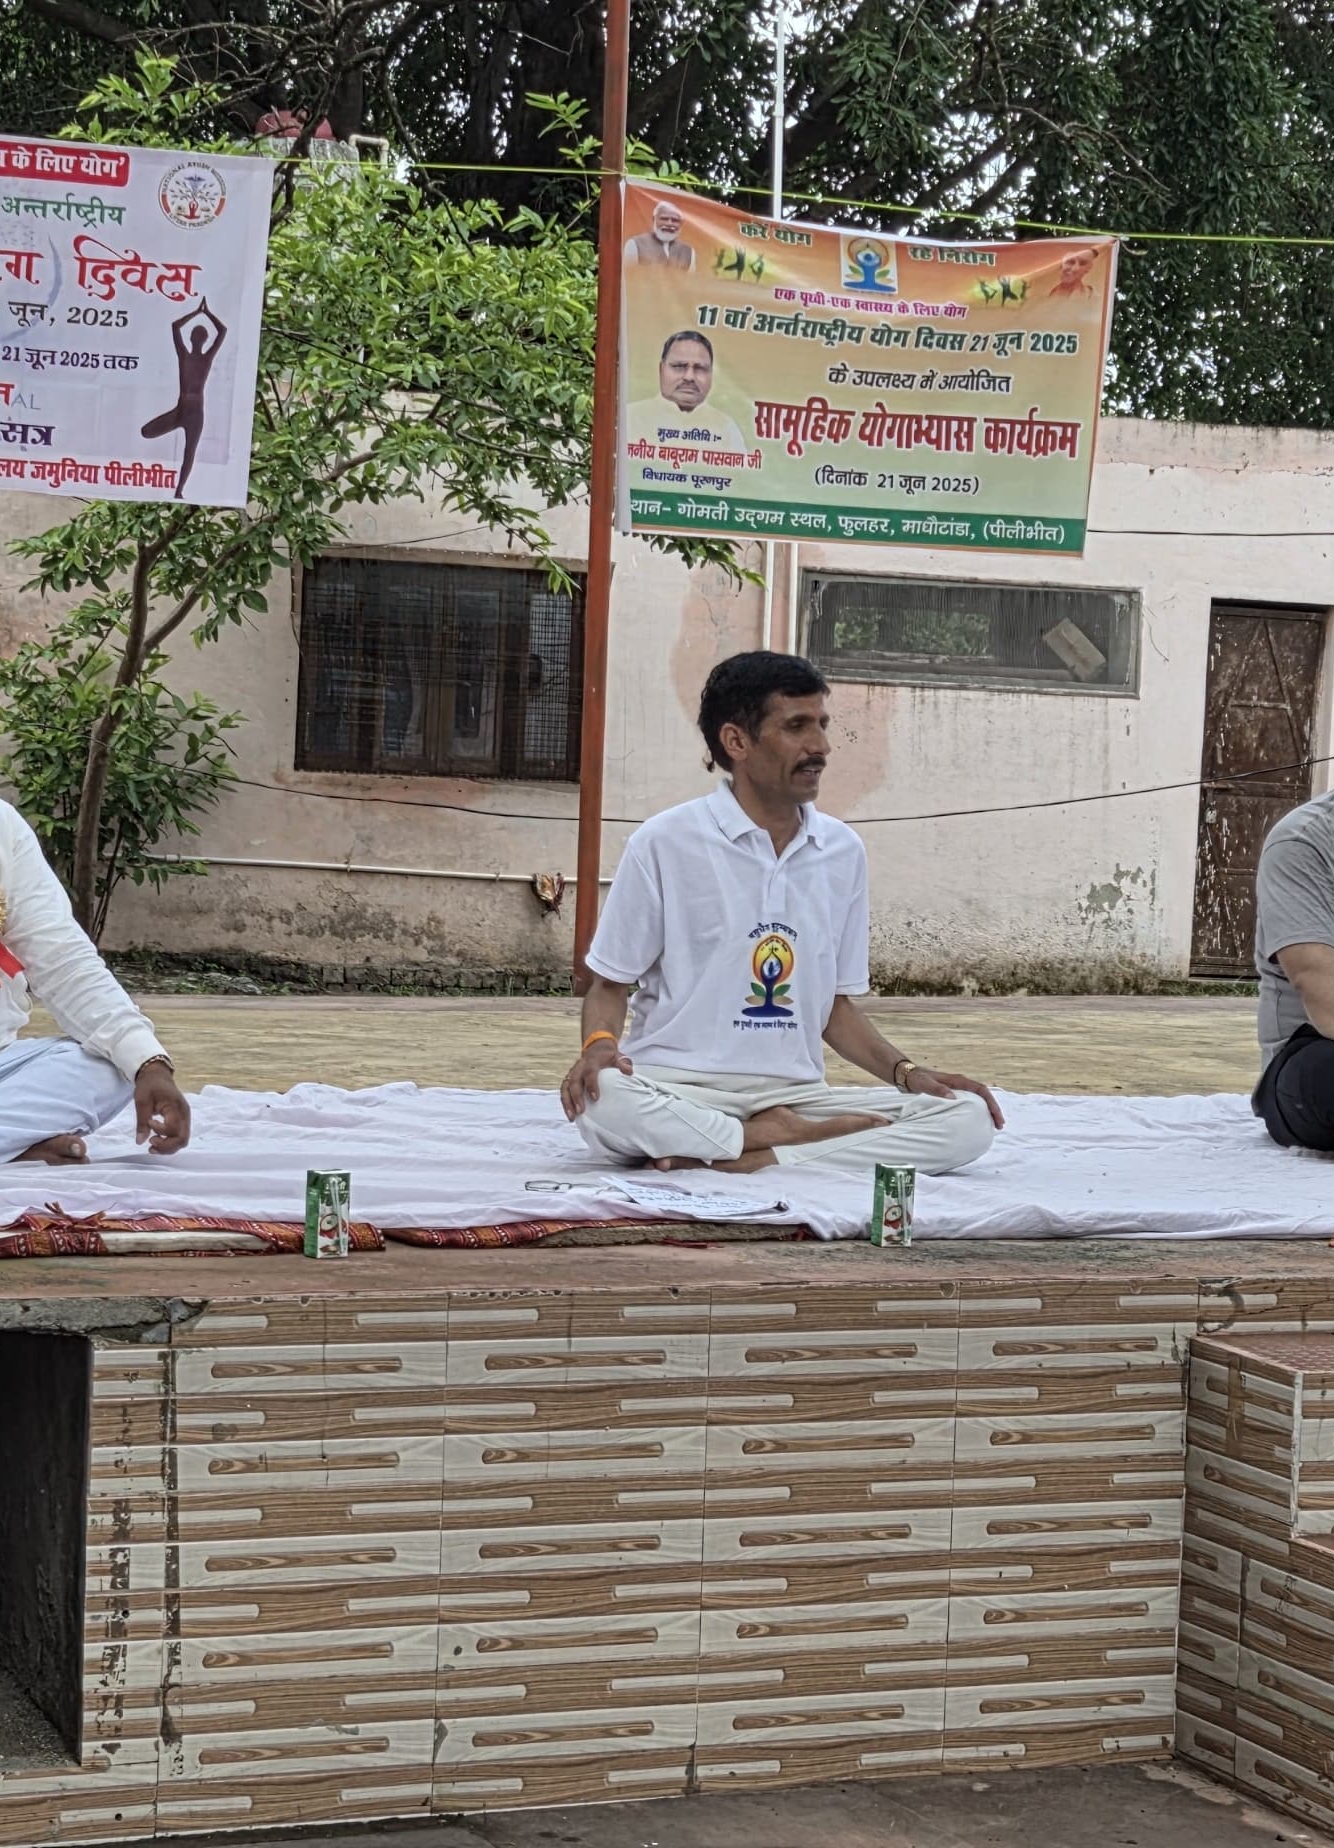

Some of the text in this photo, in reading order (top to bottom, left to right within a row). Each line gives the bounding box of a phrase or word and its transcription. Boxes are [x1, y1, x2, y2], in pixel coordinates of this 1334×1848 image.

[11, 146, 32, 170] के
[35, 148, 77, 173] लिए
[1, 192, 126, 228] अन्तर्राष्ट्रीय
[8, 301, 55, 327] जून,
[67, 306, 128, 327] 2025
[774, 288, 797, 301] एक
[897, 301, 909, 313] के
[913, 302, 940, 316] लिए
[944, 304, 967, 318] योग
[698, 305, 718, 325] 11
[724, 306, 752, 329] वां
[869, 323, 910, 348] योग
[915, 326, 967, 351] दिवस
[969, 334, 990, 352] 21
[992, 332, 1025, 356] जून
[1030, 333, 1078, 354] 2025
[2, 346, 21, 362] 21
[25, 348, 57, 370] जून
[60, 351, 100, 369] 2025
[103, 354, 139, 371] तक
[828, 362, 1011, 393] के उपलक्ष्य में आयोजित
[0, 421, 55, 446] सत्र
[658, 428, 679, 442] मुख्य
[754, 396, 1081, 458] सामूहिक योगाभ्यास कार्यक्रम
[658, 445, 699, 469] बाबूराम
[702, 449, 744, 468] पासवान
[747, 449, 762, 469] जी
[30, 458, 100, 488] जमुनिया
[104, 461, 177, 489] पीलीभीत
[642, 467, 688, 483] विधायक
[814, 464, 980, 495] (दिनांक 21 जून 2025)
[677, 497, 730, 521] गोमती
[790, 512, 831, 532] स्थल,
[837, 516, 895, 536] फुलहर,
[983, 520, 1065, 544] (पीलीभीत)
